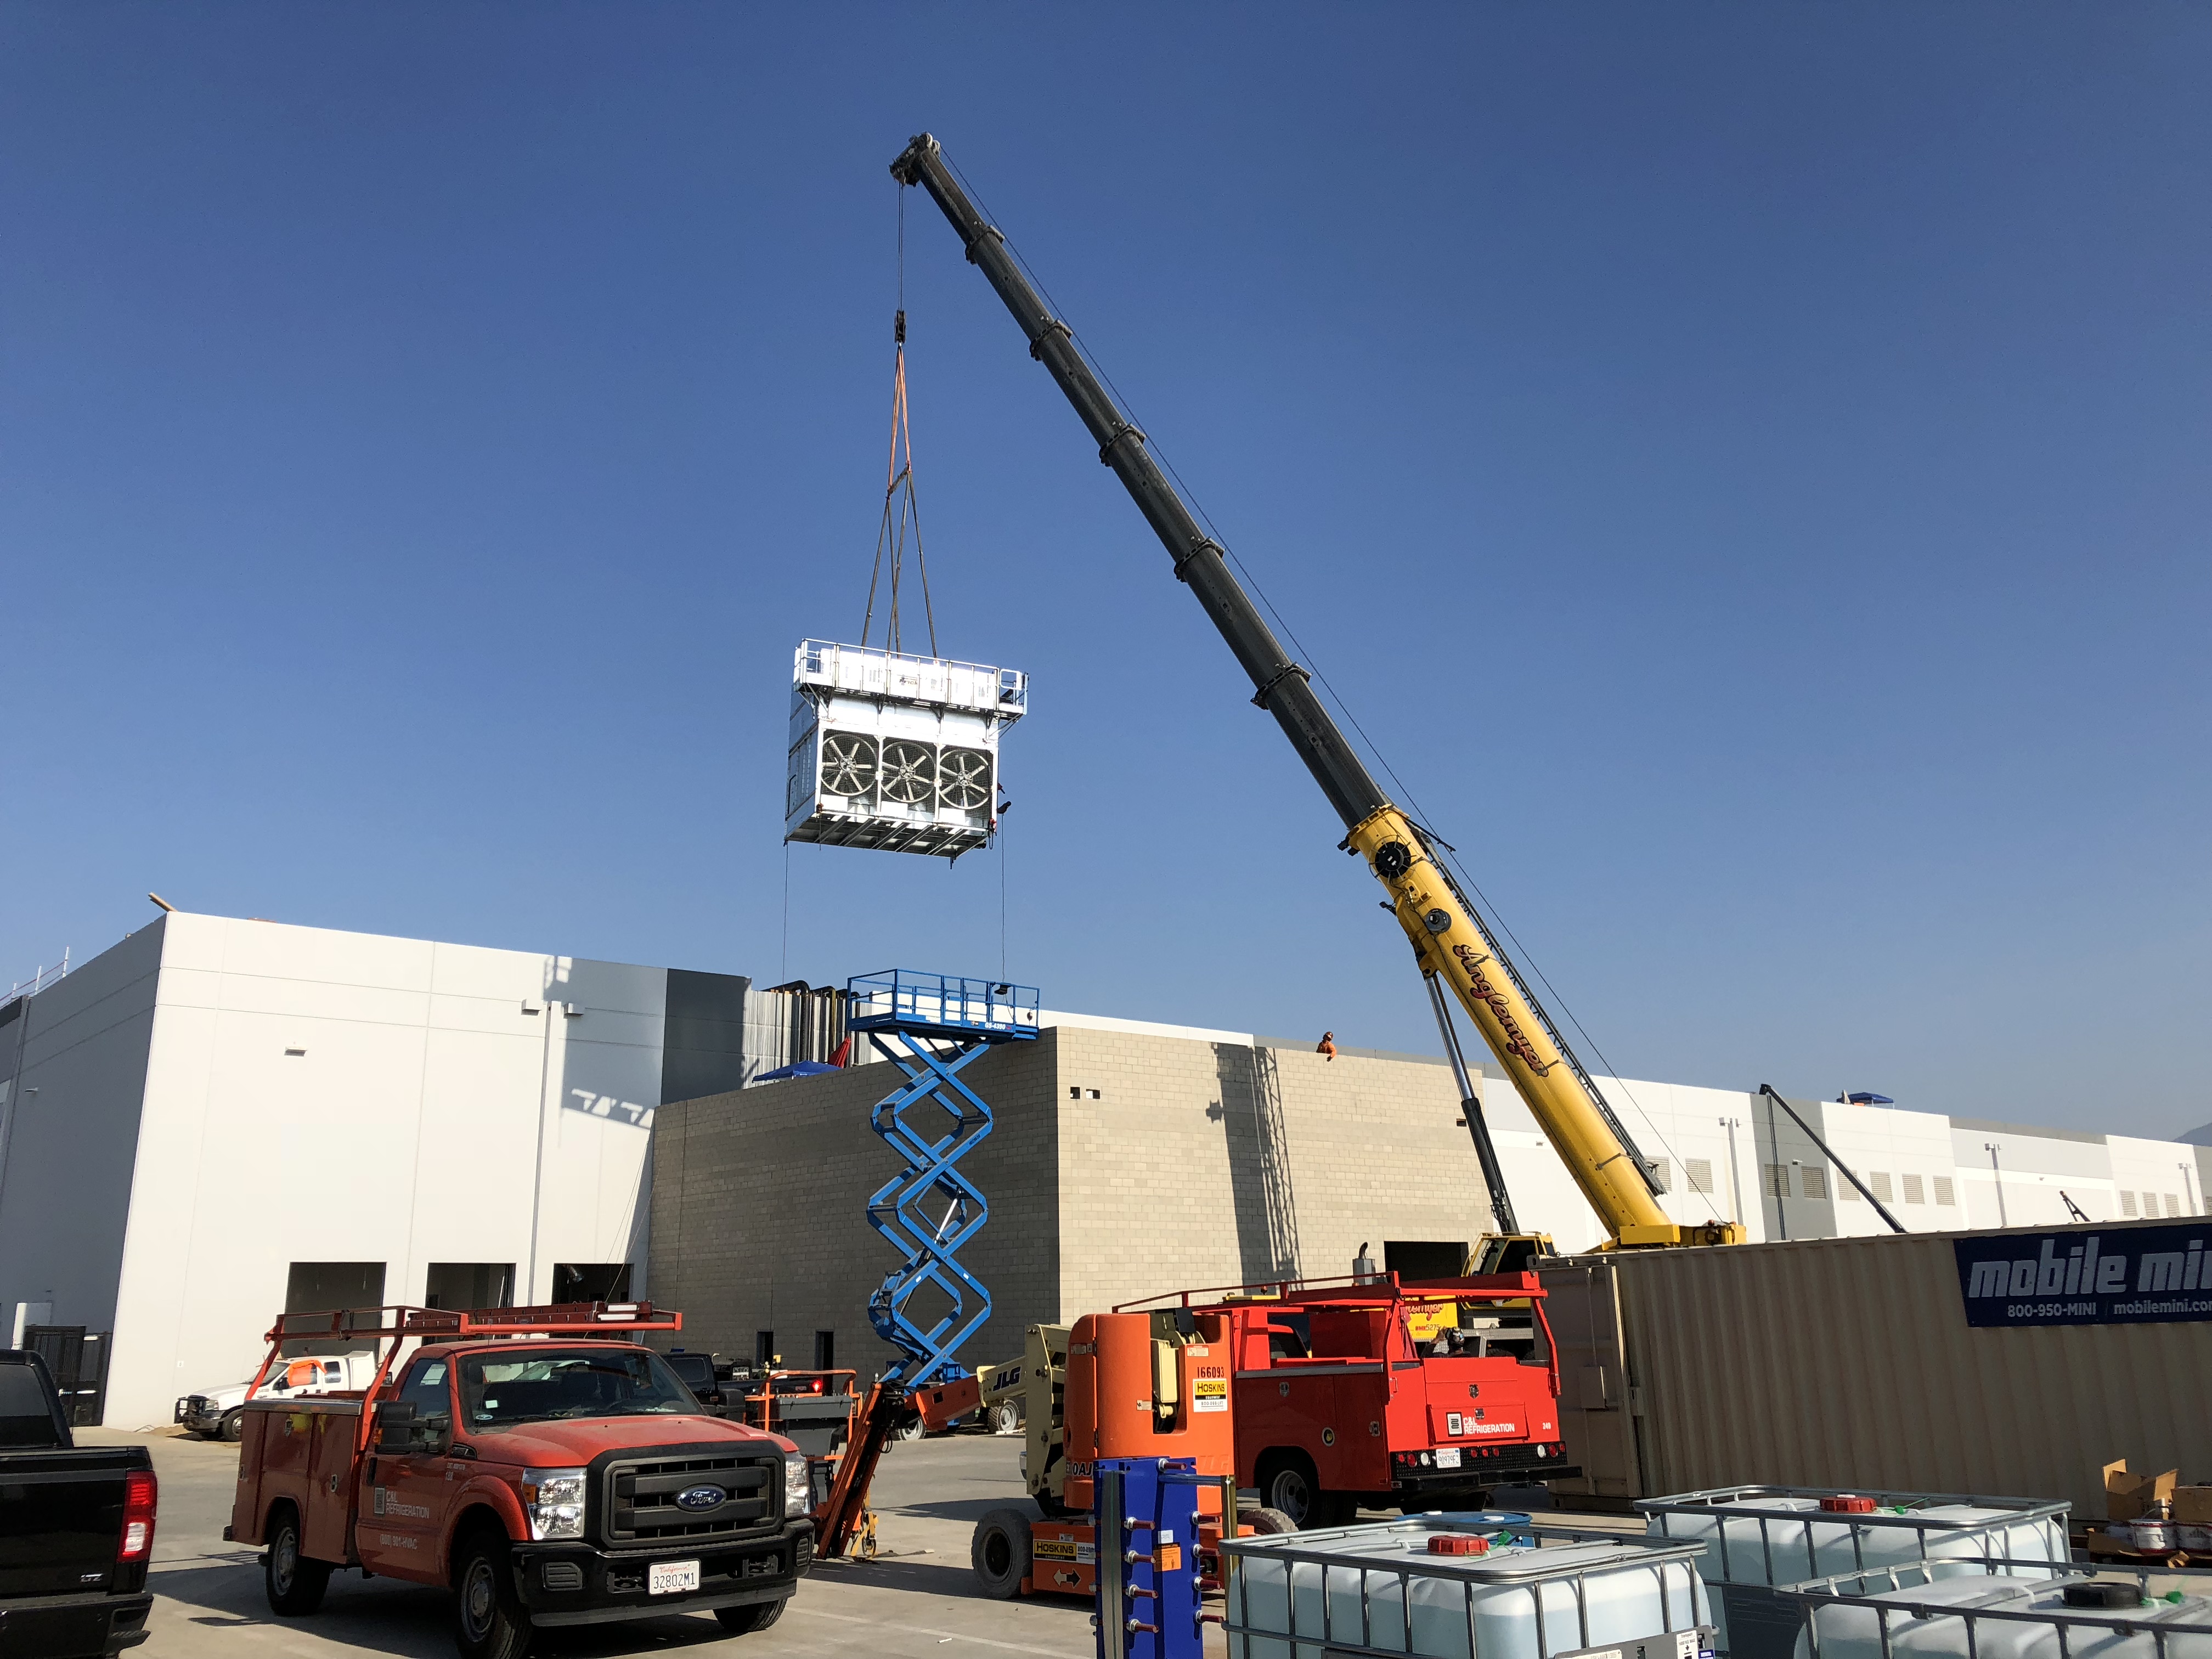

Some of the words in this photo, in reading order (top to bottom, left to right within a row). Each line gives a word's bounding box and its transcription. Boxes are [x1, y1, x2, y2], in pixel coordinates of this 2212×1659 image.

[1968, 1237, 2126, 1298] mobile
[2007, 1302, 2096, 1317] 800-950-MINI
[992, 1366, 1021, 1391] JLG
[1197, 1367, 1224, 1378] 166093
[1197, 1383, 1224, 1392] HOSKINS
[1463, 1416, 1477, 1426] C&L
[1464, 1424, 1515, 1435] REFRIGERATION
[690, 1490, 716, 1505] Ford
[386, 1502, 430, 1519] REFRIGERATION
[1036, 1542, 1074, 1554] HOSKINS
[653, 1572, 696, 1589] 32802M1
